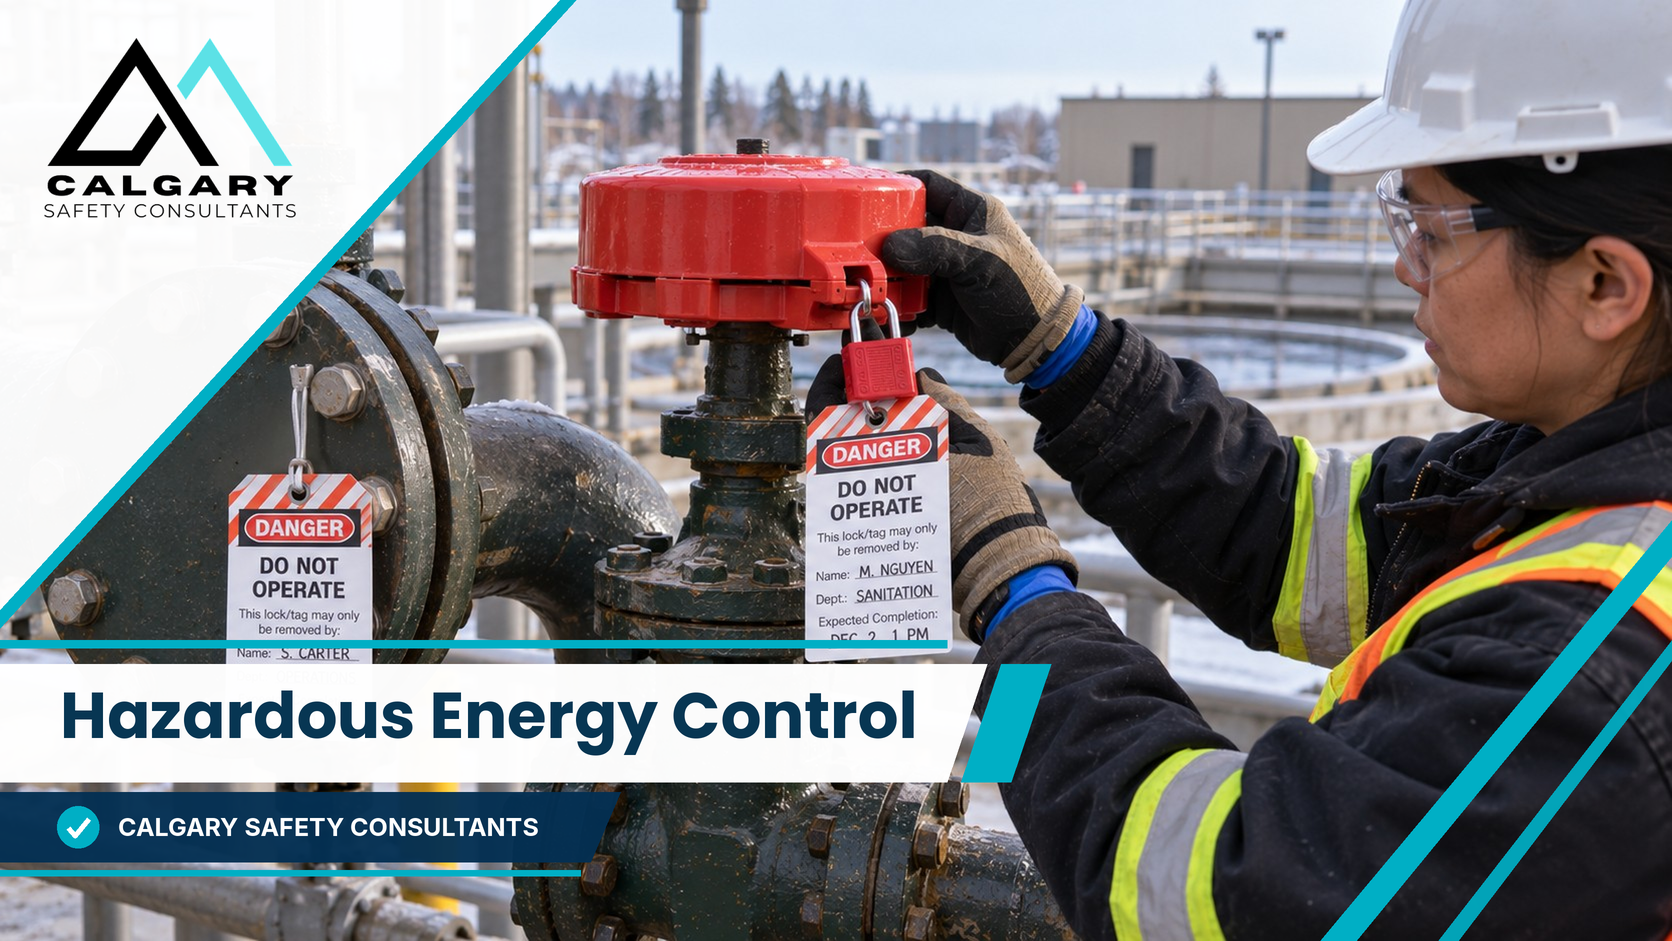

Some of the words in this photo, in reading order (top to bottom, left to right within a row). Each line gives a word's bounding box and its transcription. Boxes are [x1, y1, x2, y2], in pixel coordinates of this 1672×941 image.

[832, 438, 921, 464] DANGER
[838, 480, 867, 498] DO
[874, 474, 917, 495] NOT
[830, 496, 923, 521] OPERATE
[255, 519, 344, 537] DANGER
[817, 532, 839, 543] This
[842, 529, 886, 540] lock/tag
[889, 527, 912, 537] may
[915, 523, 938, 535] only
[837, 546, 851, 556] be
[853, 541, 900, 555] removed
[903, 540, 919, 551] by:
[260, 556, 289, 574] DO
[297, 557, 339, 574] NOT
[816, 571, 850, 581] Name:
[859, 565, 874, 578] M.
[880, 560, 934, 576] NGUYEN
[252, 580, 345, 599] OPERATE
[816, 594, 848, 606] Dept.:
[856, 584, 933, 603] SANITATION
[239, 608, 261, 620] This
[264, 609, 308, 622] lock/tag
[311, 611, 334, 622] may
[337, 610, 360, 623] only
[818, 614, 870, 628] Expected
[872, 609, 938, 624] Completion:
[258, 624, 273, 635] be
[275, 625, 322, 635] removed
[324, 625, 341, 637] by:
[907, 627, 929, 640] PM
[237, 648, 271, 658] Name:
[299, 648, 350, 660] CARTER
